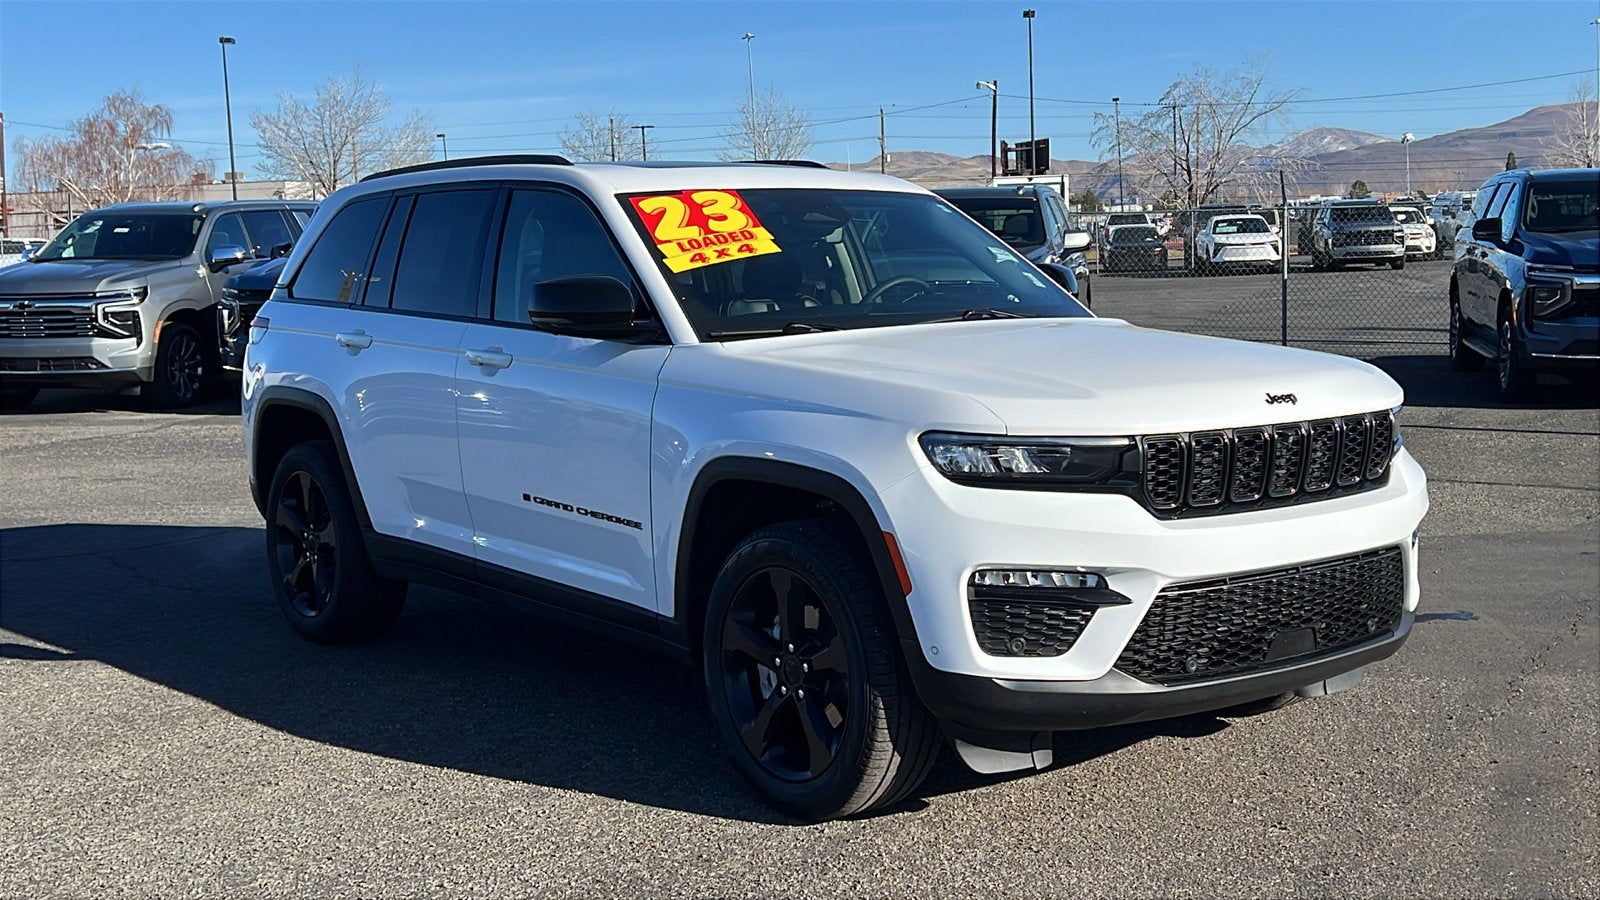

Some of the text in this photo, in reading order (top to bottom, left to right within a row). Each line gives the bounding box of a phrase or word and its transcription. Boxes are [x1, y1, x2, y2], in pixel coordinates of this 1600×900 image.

[638, 191, 753, 241] 23
[676, 229, 756, 253] LOADED
[1265, 393, 1298, 405] Jeep
[533, 496, 643, 530] GRAND CHEROKEE
